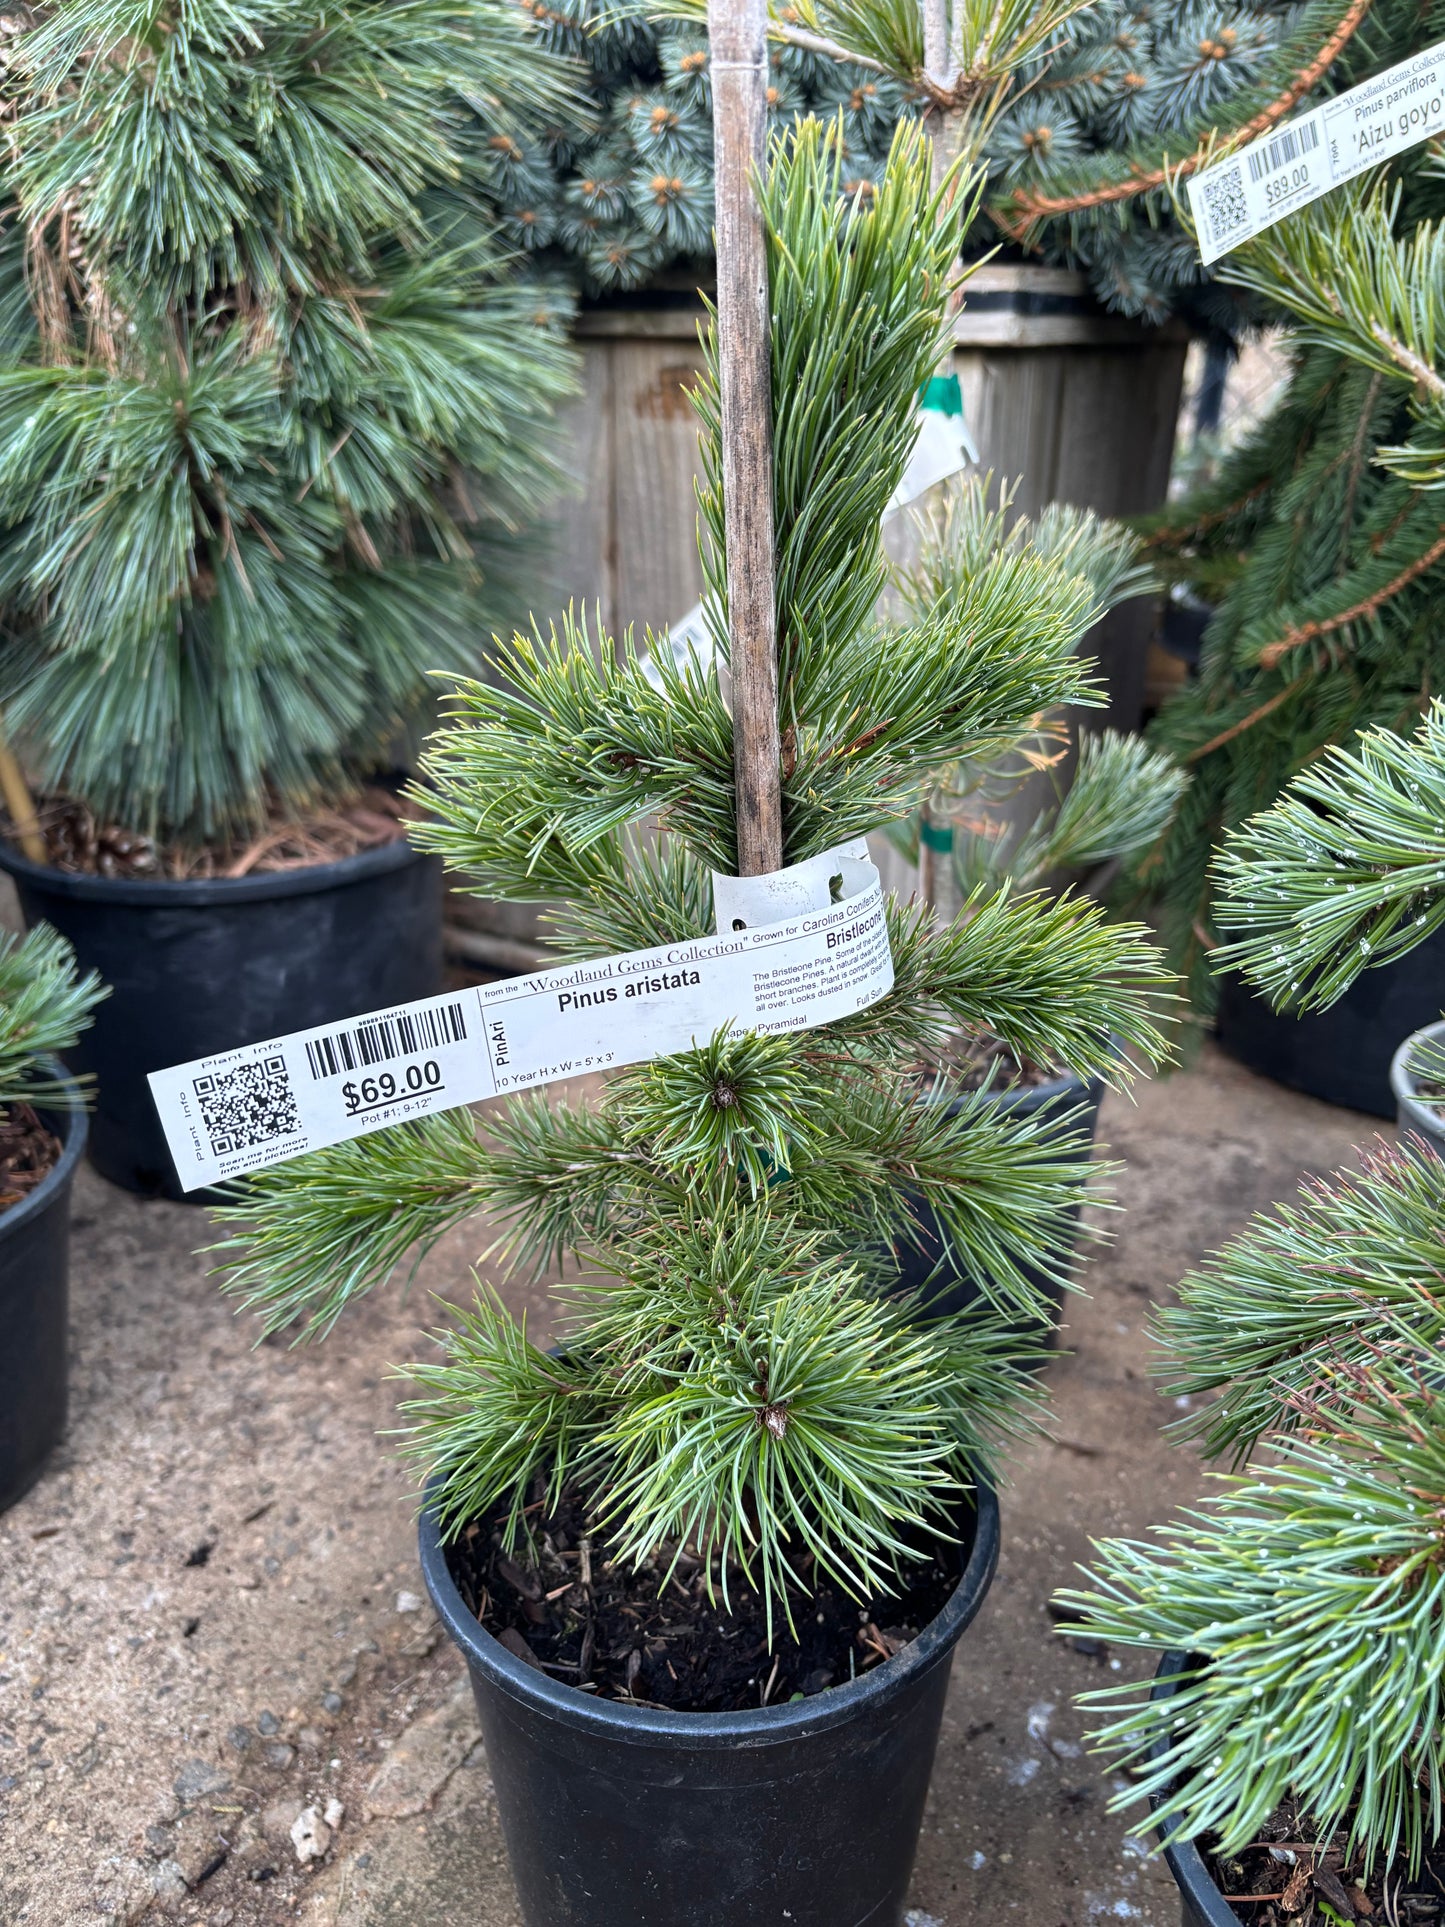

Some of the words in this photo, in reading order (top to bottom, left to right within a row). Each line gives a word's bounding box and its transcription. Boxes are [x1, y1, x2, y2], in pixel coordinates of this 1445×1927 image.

[1354, 99, 1384, 122] Pinus
[1386, 72, 1436, 109] parviflora
[1352, 121, 1393, 154] 'Aizu
[1398, 88, 1444, 136] goyo'
[1266, 164, 1308, 202] $89.00
[484, 989, 504, 998] from
[506, 985, 518, 994] the
[523, 964, 612, 992] "Woodland
[618, 957, 662, 974] Gems
[668, 936, 748, 964] Collection"
[752, 930, 784, 943] Grown
[786, 926, 798, 936] for
[802, 911, 844, 932] Carolina
[846, 894, 874, 916] Conifers
[826, 910, 881, 949] Bristlecone
[753, 972, 770, 982] The
[772, 962, 812, 976] Bristleone
[814, 956, 834, 968] Pine.
[836, 947, 854, 960] Some
[856, 942, 862, 951] of
[754, 976, 800, 992] Bristlecone
[802, 968, 827, 981] Pines.
[829, 965, 835, 973] A
[836, 954, 859, 970] natural
[860, 946, 874, 960] dwarf
[755, 990, 776, 1002] short
[778, 982, 819, 998] branches.
[821, 974, 840, 986] Plant
[849, 955, 878, 976] completely
[558, 988, 618, 1012] Pinus
[624, 968, 700, 998] aristata
[756, 1003, 766, 1012] all
[768, 1000, 789, 1010] over.
[791, 992, 816, 1006] Looks
[817, 983, 843, 1000] dusted
[844, 980, 851, 988] in
[852, 973, 869, 985] snow.
[857, 993, 869, 1007] Full
[870, 986, 882, 1000] Sun
[489, 1021, 510, 1066] PinAri
[758, 1014, 807, 1036] Pyramidal
[202, 1053, 244, 1069] Plant
[253, 1042, 283, 1054] Info
[496, 1078, 509, 1088] 10
[511, 1072, 538, 1084] Year
[540, 1067, 548, 1077] H
[560, 1061, 572, 1072] W
[585, 1056, 594, 1066] 5'
[606, 1052, 614, 1061] 3'
[180, 1092, 192, 1118] Info
[342, 1060, 440, 1112] $69.00
[361, 1113, 381, 1126] Pot
[383, 1108, 401, 1119] #1;
[403, 1097, 432, 1112] 9-12"
[190, 1126, 204, 1161] Plant
[219, 1156, 244, 1168] Scan
[282, 1137, 308, 1149] more
[243, 1157, 262, 1167] and
[264, 1142, 309, 1162] pictures!
